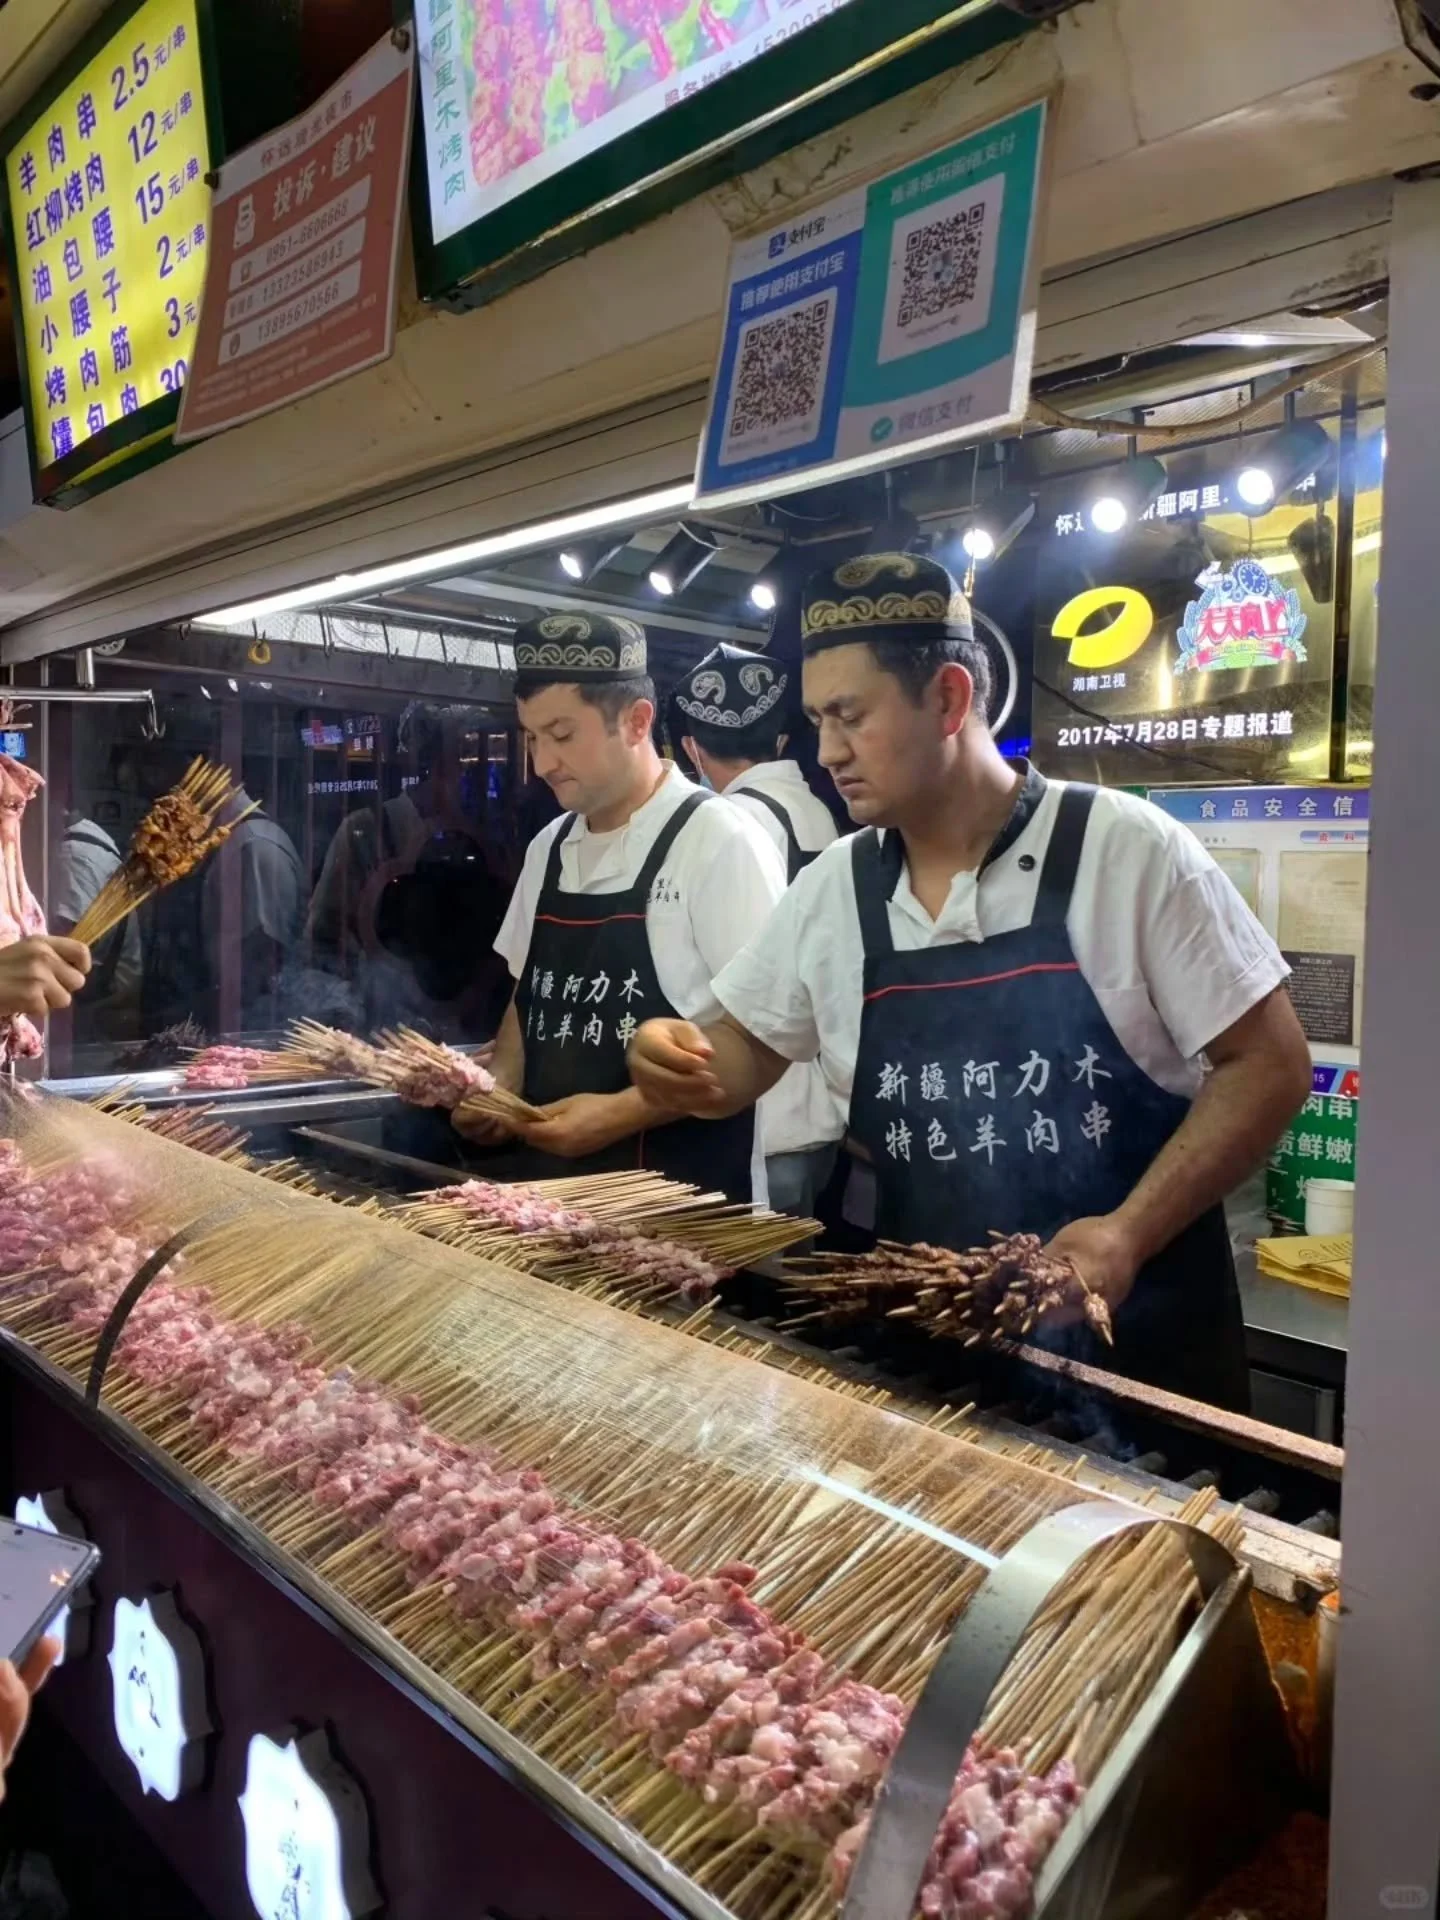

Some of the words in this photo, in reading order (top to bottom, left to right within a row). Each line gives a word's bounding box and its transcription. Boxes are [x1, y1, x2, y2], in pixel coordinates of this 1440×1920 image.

[19, 92, 97, 195] 羊肉串
[26, 152, 105, 250] 红柳烤肉
[32, 206, 114, 304] 油包腰
[740, 251, 845, 312] 推荐使用支付宝
[41, 267, 121, 354] 小腰子
[45, 325, 131, 408] 烤肉筋
[899, 391, 975, 434] 微信支付
[1196, 597, 1290, 646] 天天向上
[1072, 672, 1126, 692] 湖南卫视
[1057, 710, 1294, 747] 2017年7月28日专题报道
[1200, 796, 1354, 817] 食品安全信
[875, 1044, 1113, 1106] 新疆阿力木
[885, 1101, 1113, 1166] 特色羊肉串
